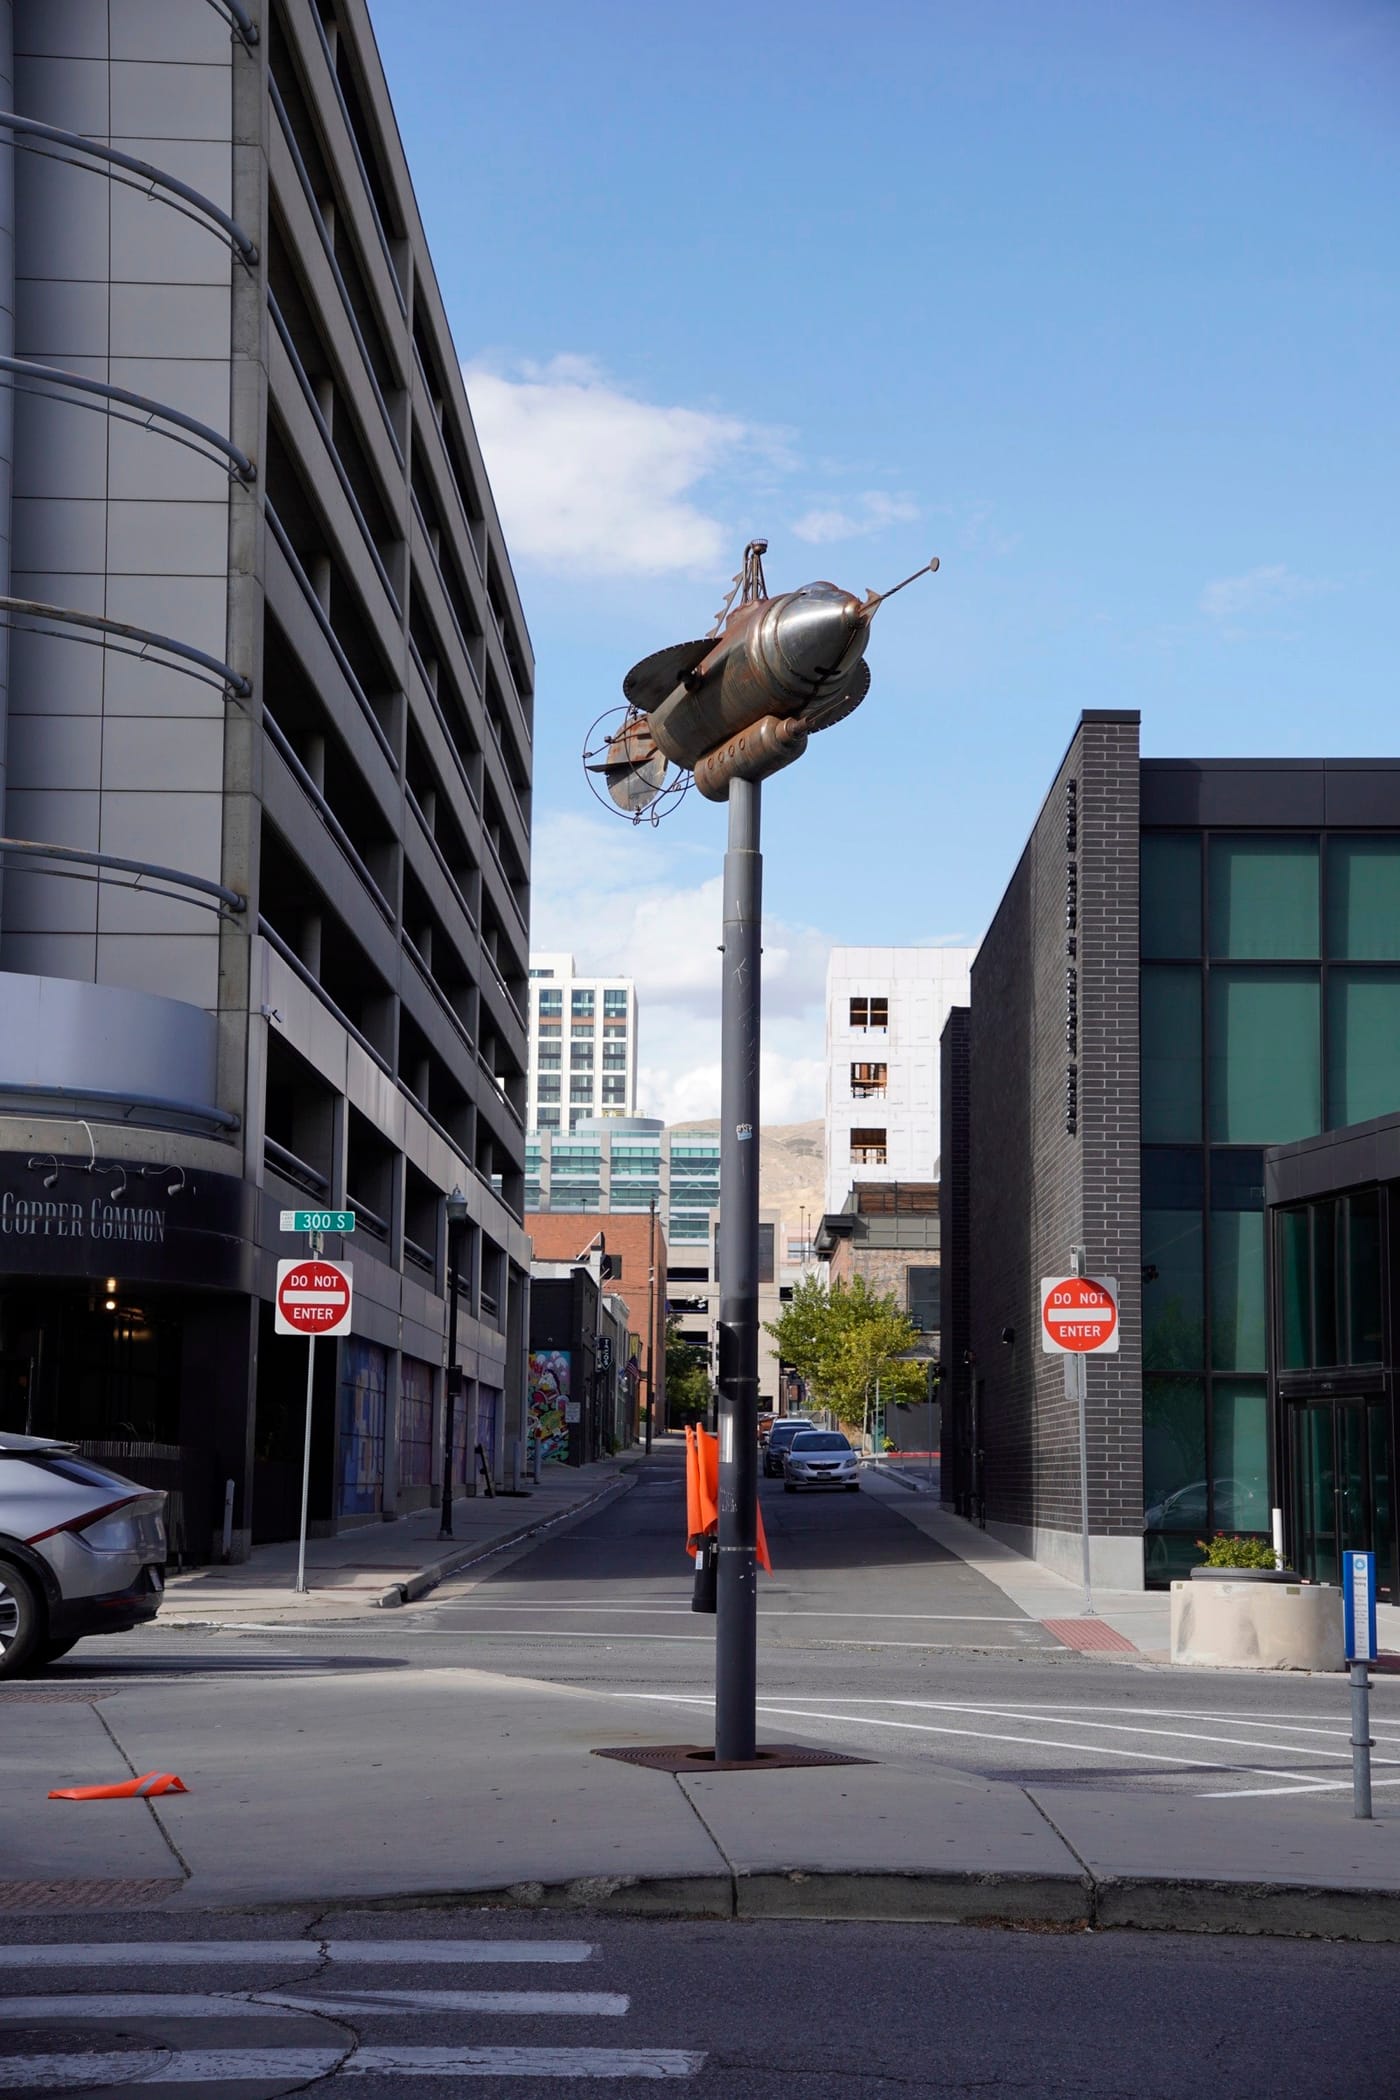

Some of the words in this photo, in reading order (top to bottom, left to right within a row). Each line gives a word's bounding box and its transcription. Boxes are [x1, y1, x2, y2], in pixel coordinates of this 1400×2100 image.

[2, 1192, 84, 1237] COPPER
[90, 1197, 166, 1243] COMMON
[303, 1214, 331, 1229] 300
[336, 1214, 346, 1229] S
[291, 1275, 308, 1287] DO
[314, 1275, 339, 1288] NOT
[1054, 1293, 1072, 1305] DO
[1080, 1293, 1105, 1304] NOT
[293, 1307, 334, 1320] ENTER
[1060, 1326, 1101, 1337] ENTER
